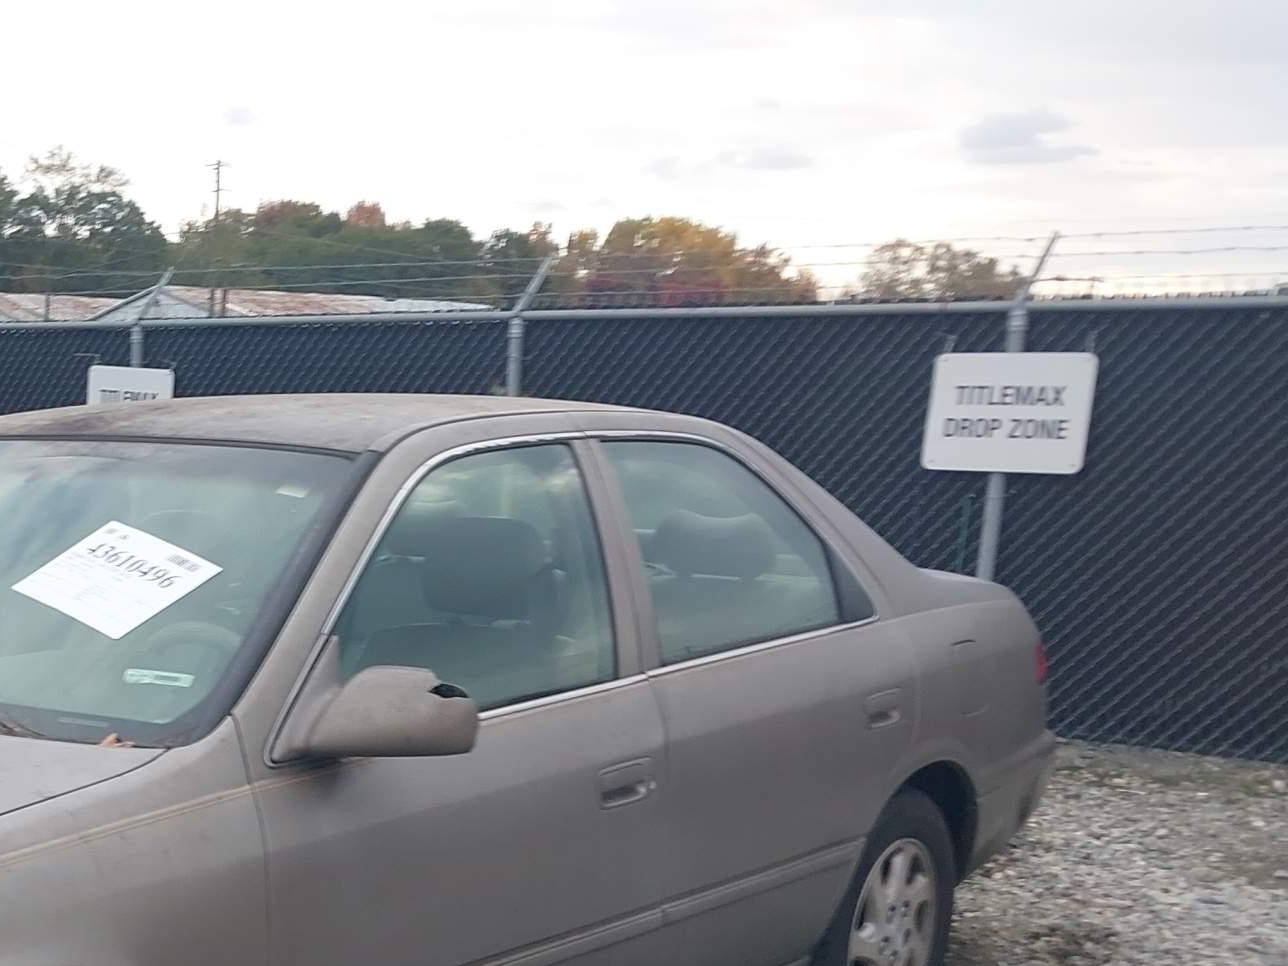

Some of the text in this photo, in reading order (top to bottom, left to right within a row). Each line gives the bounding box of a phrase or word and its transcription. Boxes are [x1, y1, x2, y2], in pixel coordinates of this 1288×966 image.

[955, 385, 1067, 406] TITLEMAX
[944, 418, 1070, 440] DROP ZONE
[87, 543, 181, 589] 43610496
